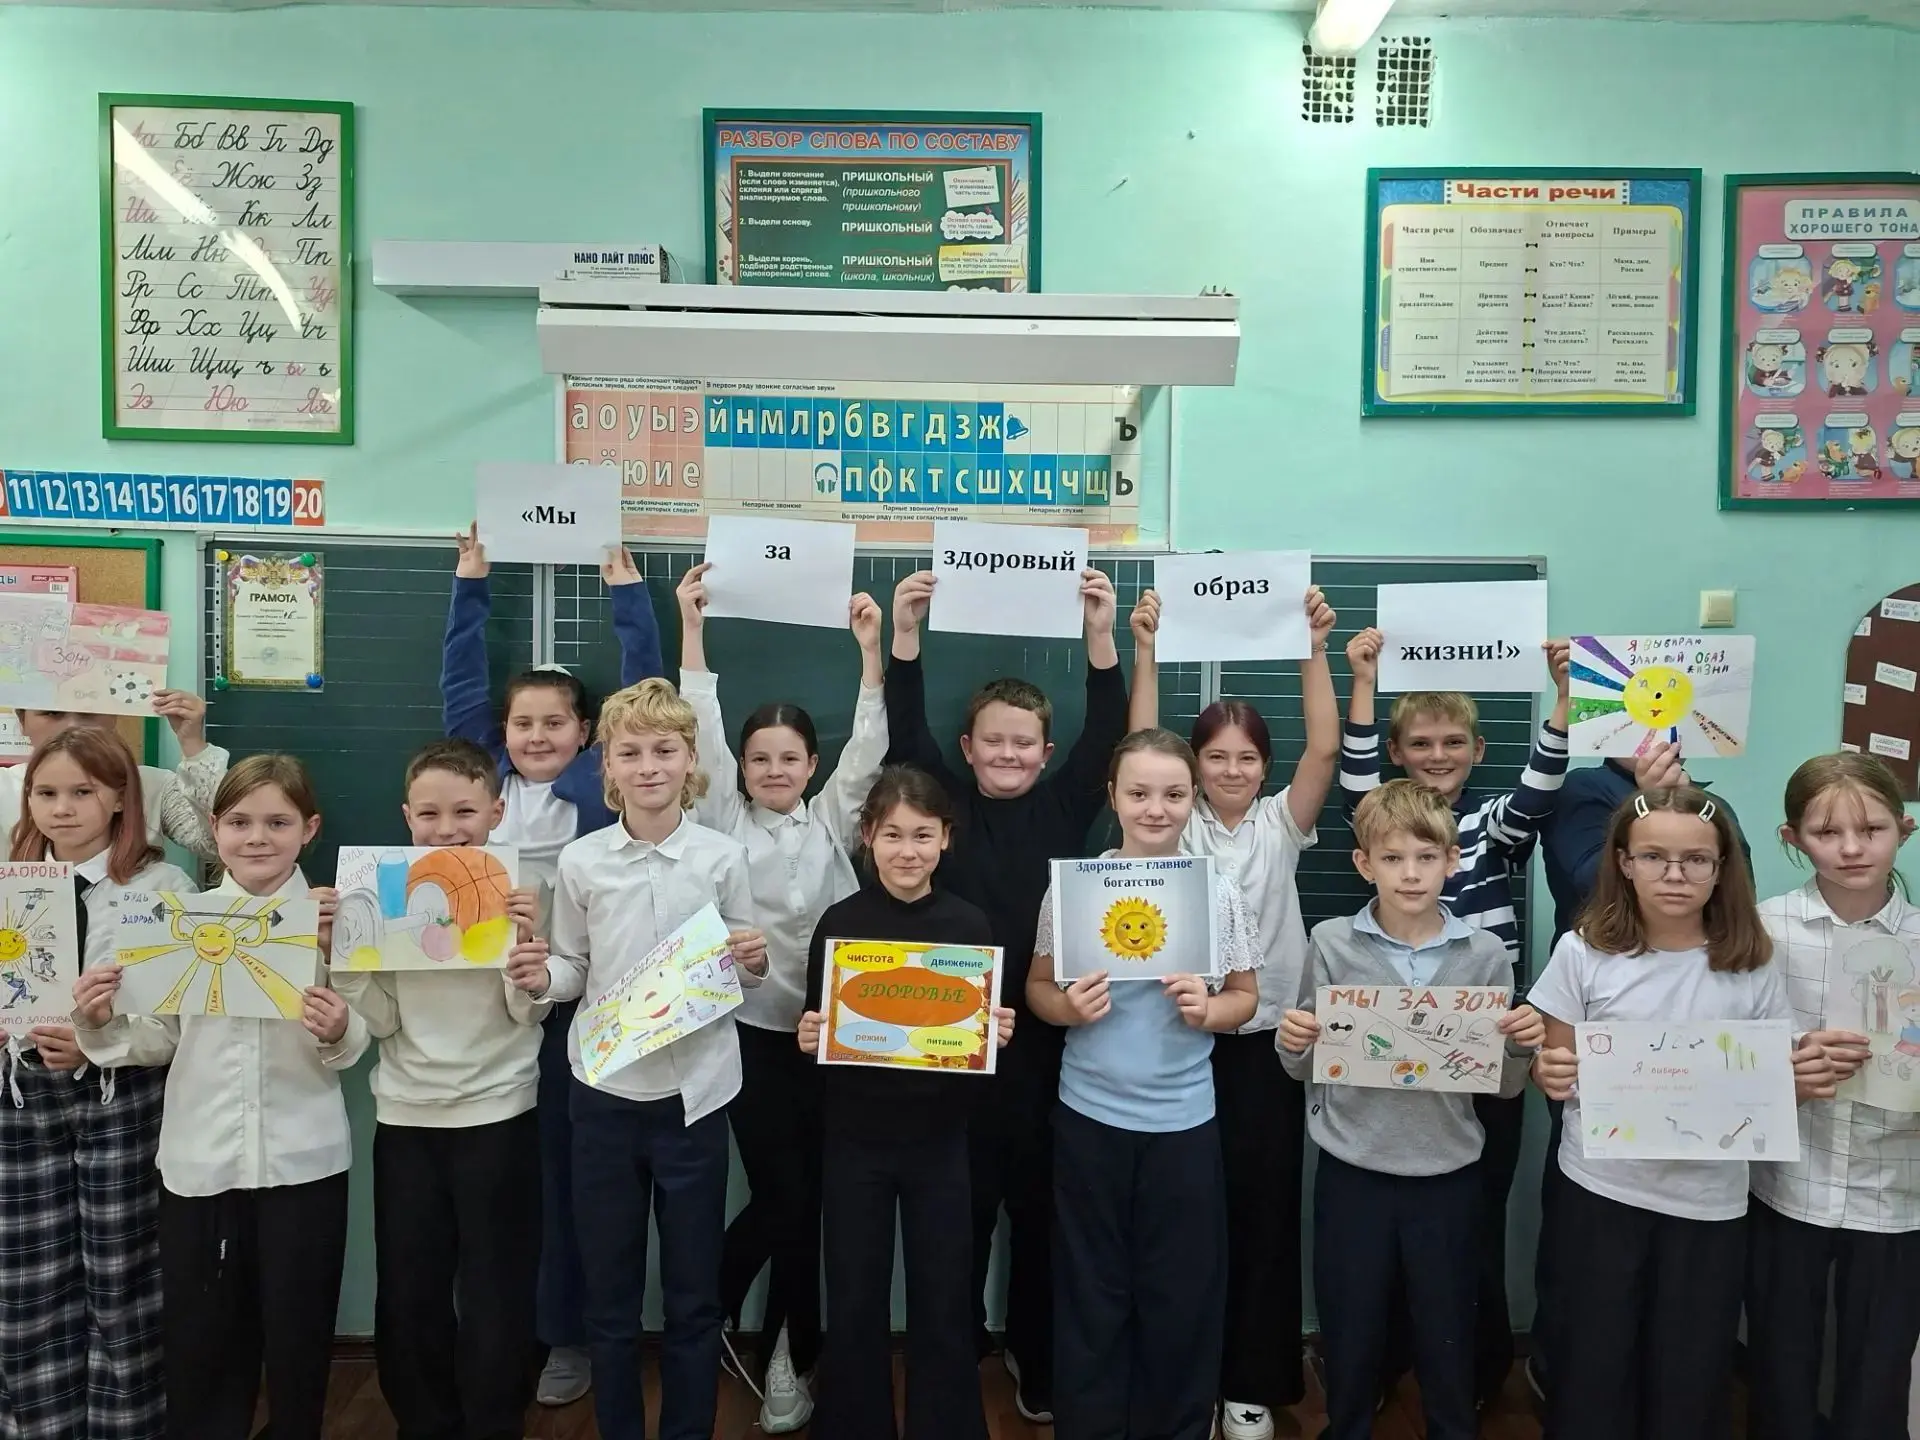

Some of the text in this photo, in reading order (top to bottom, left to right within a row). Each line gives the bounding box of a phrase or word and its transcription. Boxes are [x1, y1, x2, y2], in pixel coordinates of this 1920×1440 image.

[174, 122, 334, 164] Бб Вв Гг Дд
[719, 130, 1022, 151] РАЗБОР СЛОВА ПО СОСТАВУ
[748, 169, 781, 178] Выдели
[842, 170, 934, 183] ПРИШКОЛЬНЫЙ
[212, 161, 323, 201] Жж Зз
[739, 186, 773, 194] склоняя
[791, 186, 824, 196] спрягай
[842, 186, 921, 199] (пришкольного
[1456, 182, 1617, 202] Части речи
[124, 196, 332, 228] Ии Кк Лл
[842, 201, 922, 214] пришкольному)
[1801, 207, 1909, 220] ПРАВИЛА
[748, 218, 782, 227] Выдели
[782, 218, 812, 228] основу.
[841, 220, 933, 234] ПРИШКОЛЬНЫЙ
[1545, 220, 1590, 228] Отвечает
[1790, 222, 1920, 234] ХОРОШЕГО ТОНА
[1402, 226, 1455, 236] Части речи
[1470, 226, 1524, 234] Обозначает
[1554, 232, 1594, 240] вопросы
[1613, 227, 1657, 237] Примеры
[122, 235, 332, 265] Мм Нн Пп
[574, 251, 655, 265] НАНО ЛАЙТ ПЛЮС
[748, 254, 782, 264] Выдели
[782, 255, 813, 264] корень,
[842, 254, 934, 268] ПРИШКОЛЬНЫЙ
[739, 262, 834, 272] подбирая родственные
[840, 271, 936, 284] (школа, школьник)
[121, 270, 278, 307] Рр Сс Тт
[124, 308, 328, 345] Фф Хх Цц Чч
[127, 346, 175, 373] Шш
[189, 346, 244, 380] Щщ
[255, 361, 275, 375] ъ
[318, 361, 331, 376] ь
[127, 383, 153, 410] Ээ
[204, 385, 249, 411] Юю
[8, 478, 323, 519] 11 12 13 14 15 16 17 18 19 20
[520, 504, 577, 526] «Мы
[764, 542, 792, 562] за
[943, 550, 1076, 573] здоровый
[1193, 575, 1269, 601] образ
[249, 593, 298, 603] ГРАМОТА
[1400, 639, 1521, 661] жизни!»
[1627, 640, 1637, 652] Я
[1075, 861, 1133, 874] Здоровье
[1146, 859, 1193, 870] главное
[1103, 876, 1165, 888] богатство
[847, 953, 895, 964] чистота
[930, 957, 984, 969] движение
[857, 983, 968, 1004] ЗДОРОВЬЕ
[1329, 988, 1508, 1012] МЫ ЗА ЗОЖ
[855, 1033, 887, 1043] режим
[926, 1038, 963, 1047] питание
